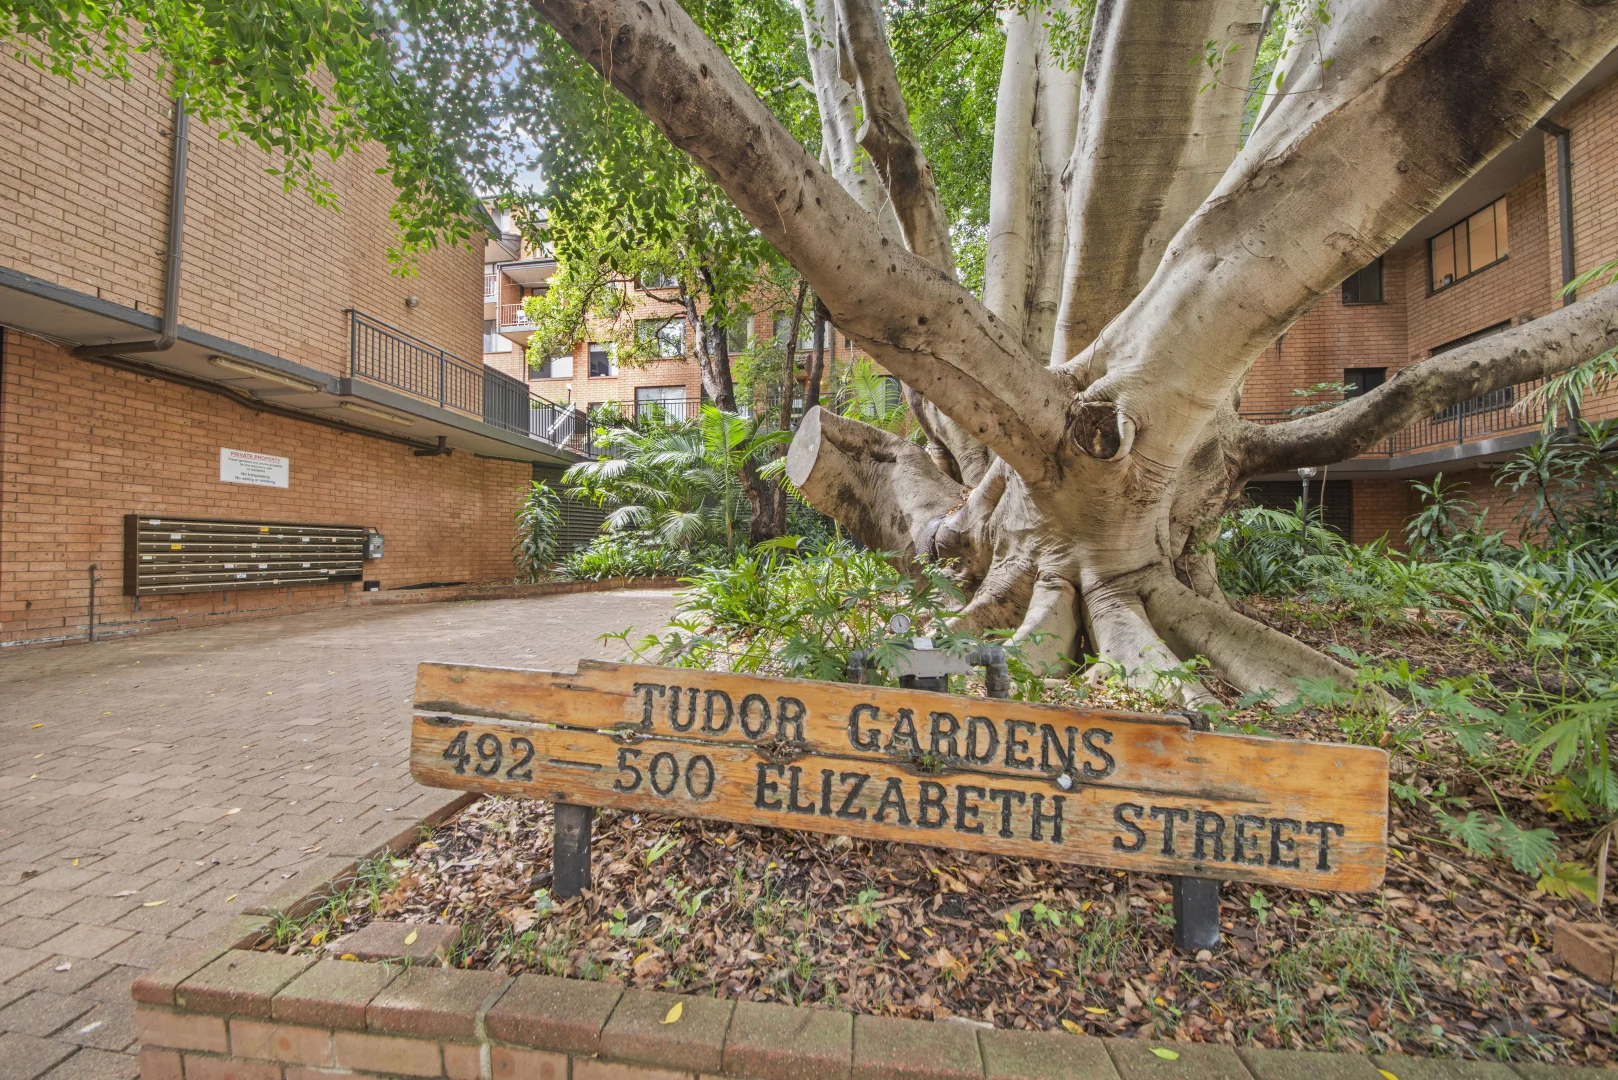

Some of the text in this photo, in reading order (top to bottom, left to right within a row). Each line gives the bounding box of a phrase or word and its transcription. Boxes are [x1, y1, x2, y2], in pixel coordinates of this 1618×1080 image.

[254, 455, 280, 463] PROPERTY
[632, 682, 1116, 780] TUDOR GARDENS
[442, 730, 536, 782] 492
[612, 747, 715, 801] 500
[754, 761, 1067, 845] ELIZABETH
[1112, 802, 1345, 873] STREET
